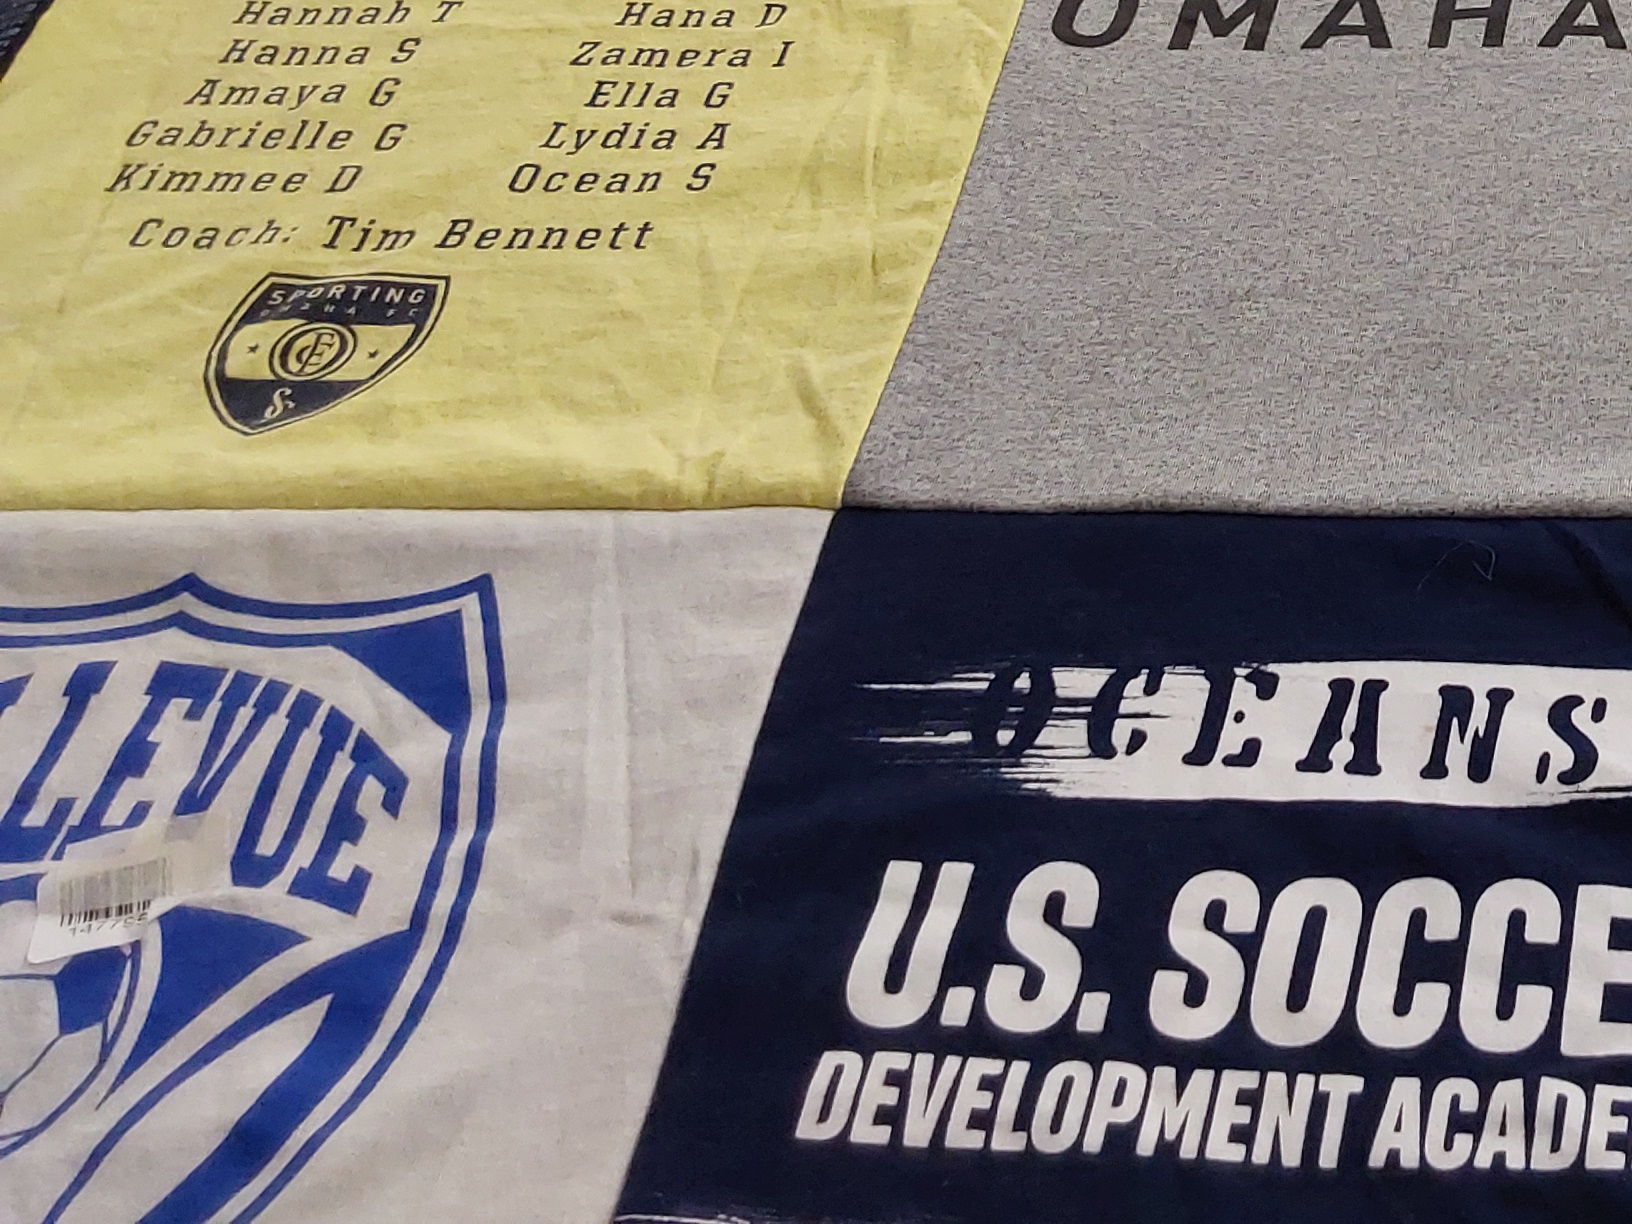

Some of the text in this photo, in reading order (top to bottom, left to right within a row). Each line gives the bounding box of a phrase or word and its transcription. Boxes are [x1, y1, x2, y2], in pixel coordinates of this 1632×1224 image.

[233, 0, 464, 25] Hannah T
[615, 2, 787, 27] Hana D
[218, 37, 421, 65] Hanna S
[569, 41, 794, 67] Zamera I
[184, 78, 401, 110] Amaya G
[584, 80, 734, 108] Ella G
[126, 120, 407, 150] Gabrielle G
[539, 122, 730, 155] Lydia A
[104, 163, 362, 193] Kimmee D
[508, 163, 716, 193] Ocean S
[129, 216, 653, 252] Coach: Tim Bennett
[267, 284, 427, 305] SPORTING
[846, 861, 1110, 1033] U.S.
[790, 1044, 1366, 1176] DEVELOPMENT
